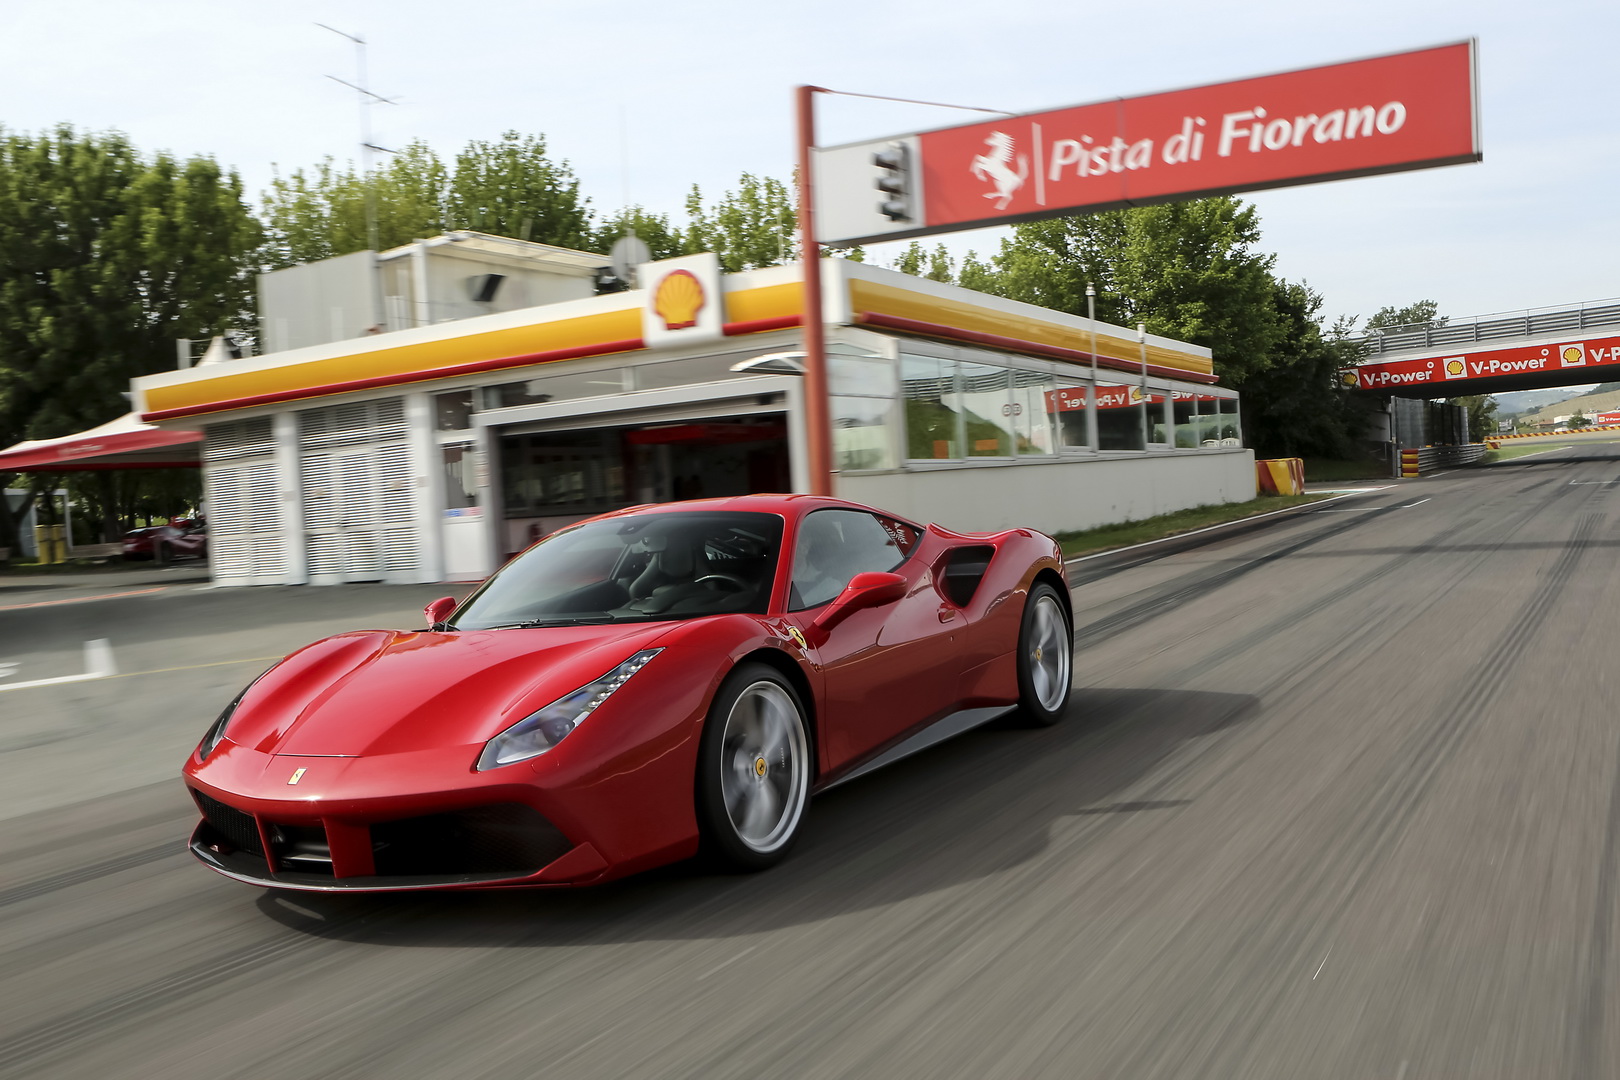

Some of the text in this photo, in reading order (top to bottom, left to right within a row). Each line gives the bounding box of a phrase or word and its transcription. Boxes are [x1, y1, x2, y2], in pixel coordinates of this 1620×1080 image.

[1048, 101, 1407, 181] Pista di Fiorano
[1470, 358, 1547, 375] V-Power
[1363, 370, 1433, 386] V-Power
